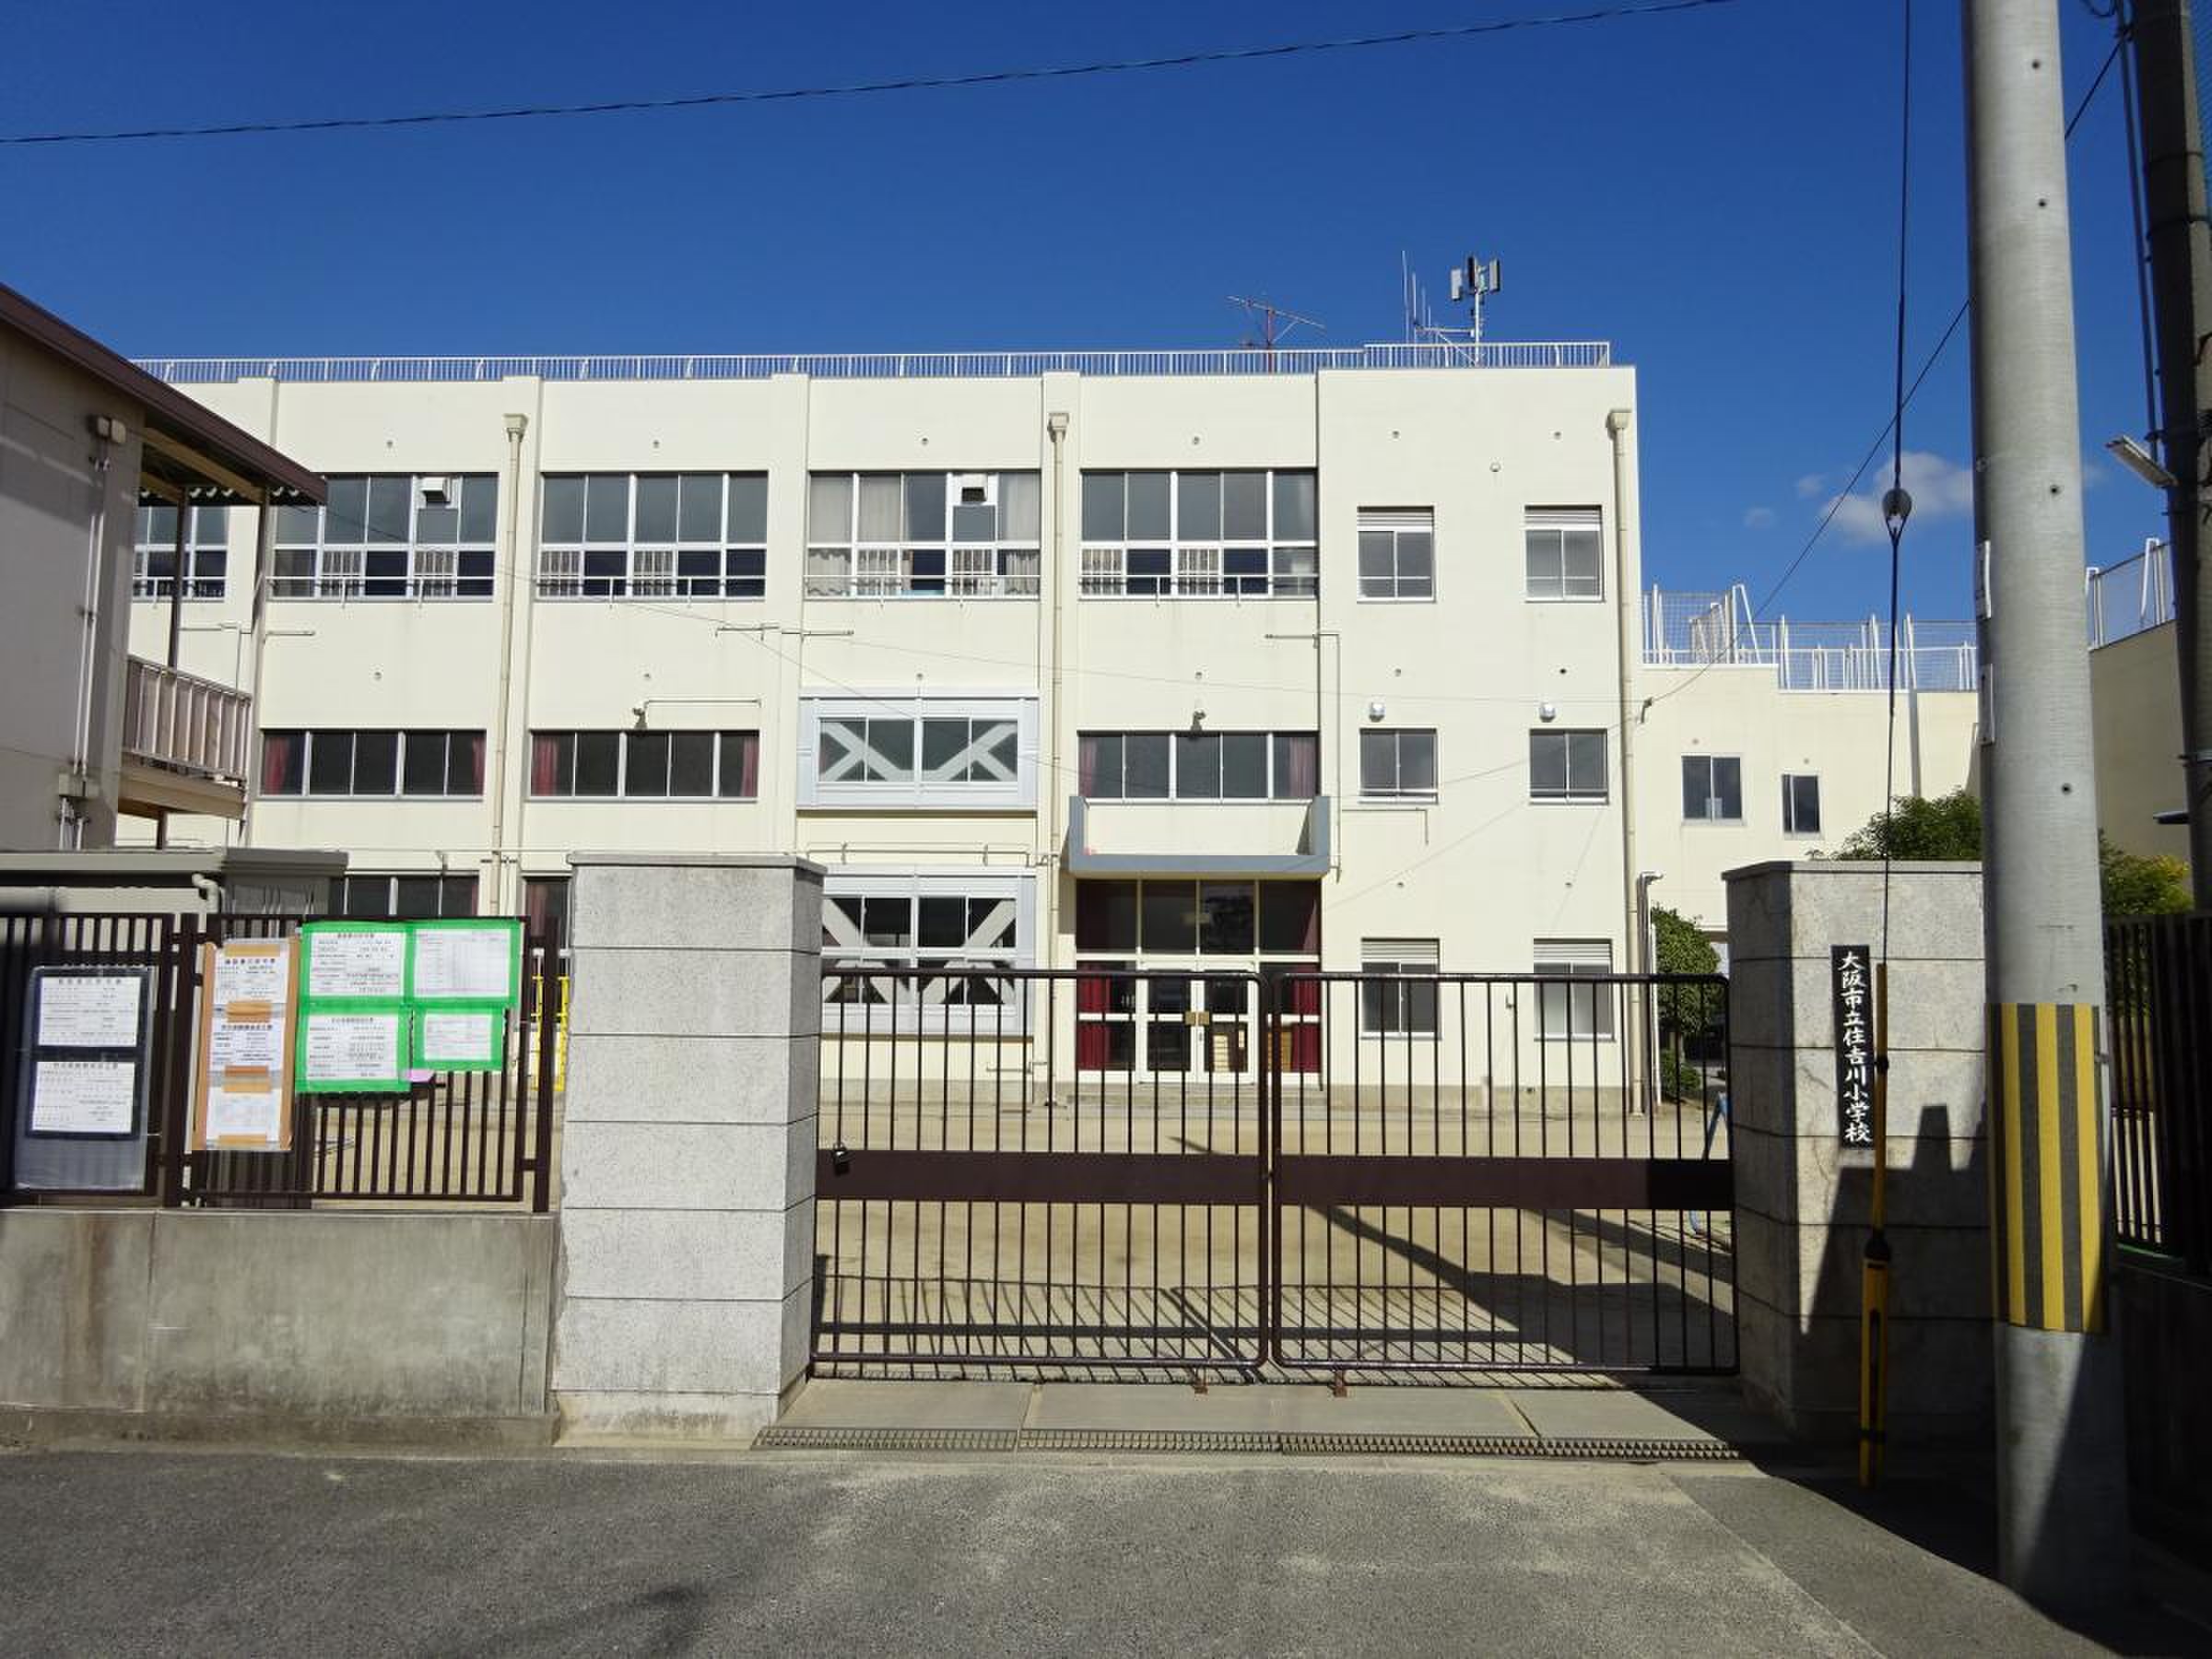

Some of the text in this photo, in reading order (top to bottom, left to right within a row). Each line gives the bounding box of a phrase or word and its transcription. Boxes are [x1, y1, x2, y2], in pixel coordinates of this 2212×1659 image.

[1837, 951, 1873, 1143] 大阪市立住吉川小学校
